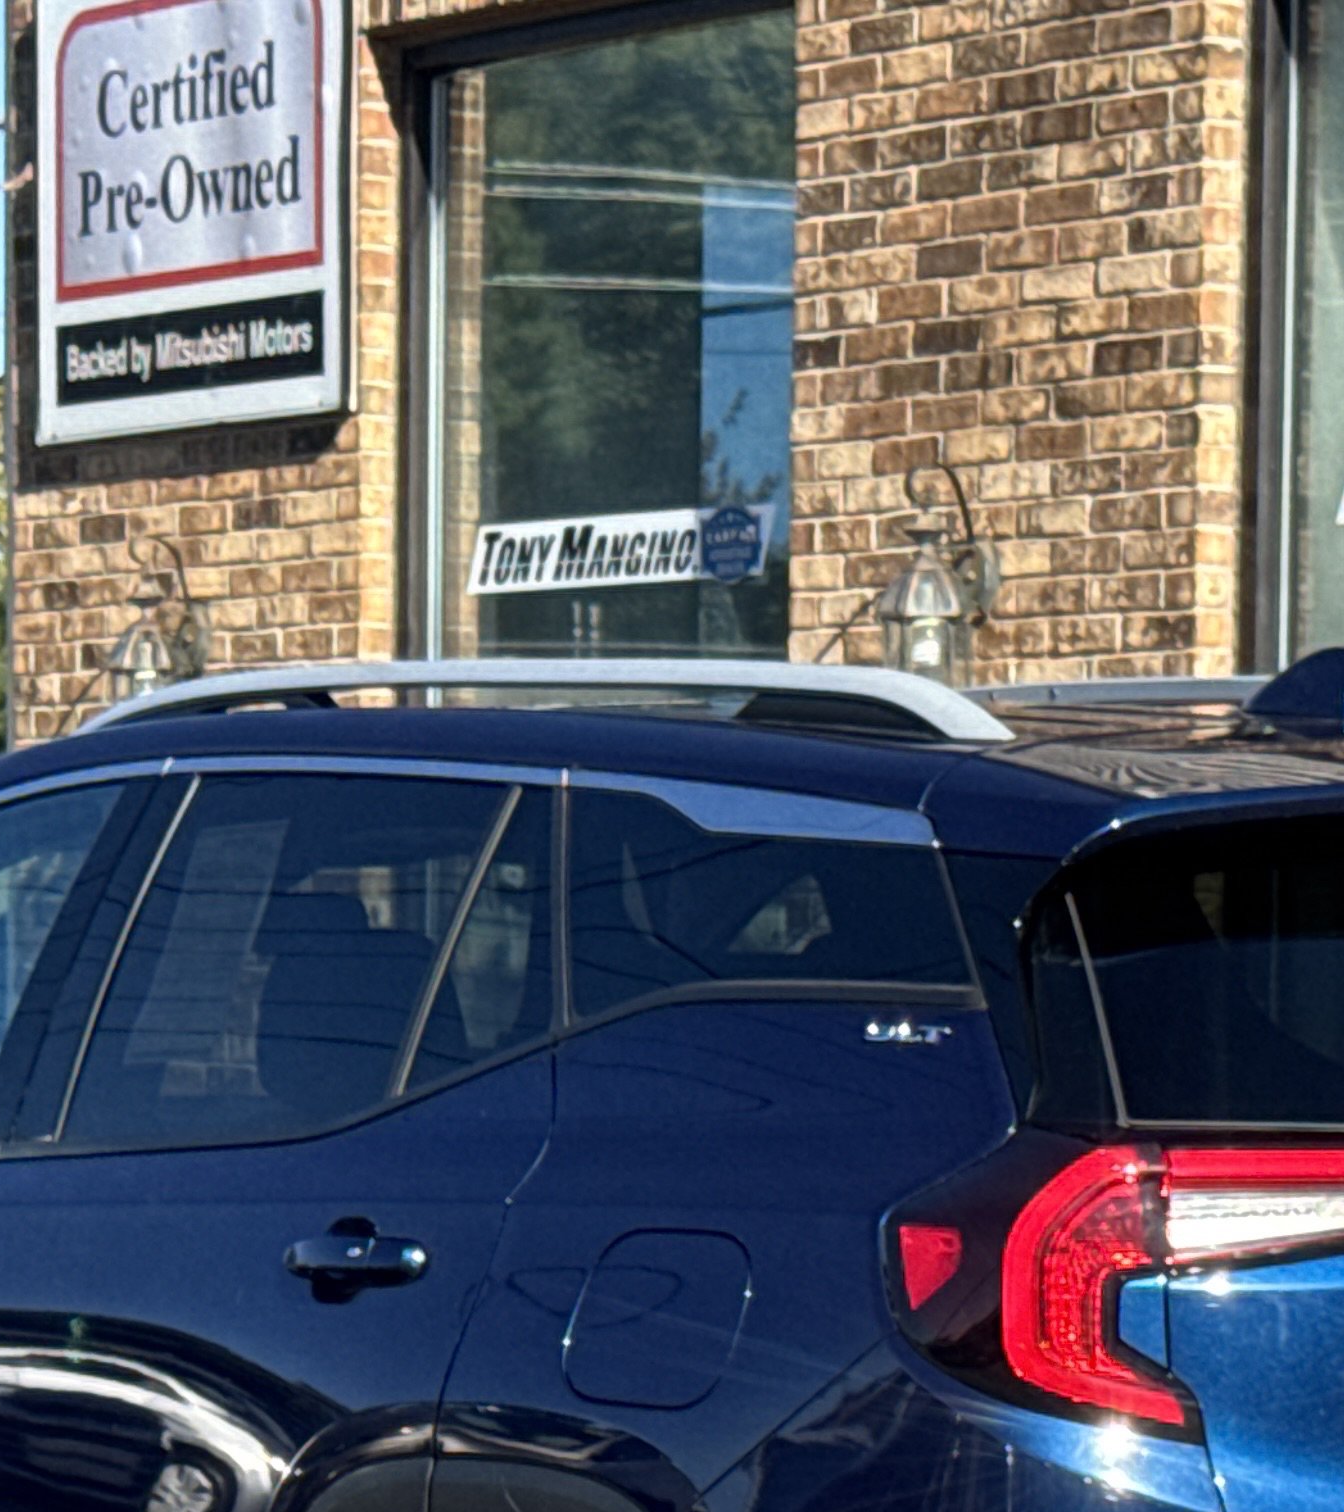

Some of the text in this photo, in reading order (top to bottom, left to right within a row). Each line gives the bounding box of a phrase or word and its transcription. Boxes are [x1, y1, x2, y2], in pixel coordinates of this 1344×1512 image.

[97, 40, 276, 138] Certified
[78, 135, 302, 238] Pre-Owned
[66, 317, 313, 383] Backed by Mitsubishi Motors
[478, 530, 555, 586] TONY
